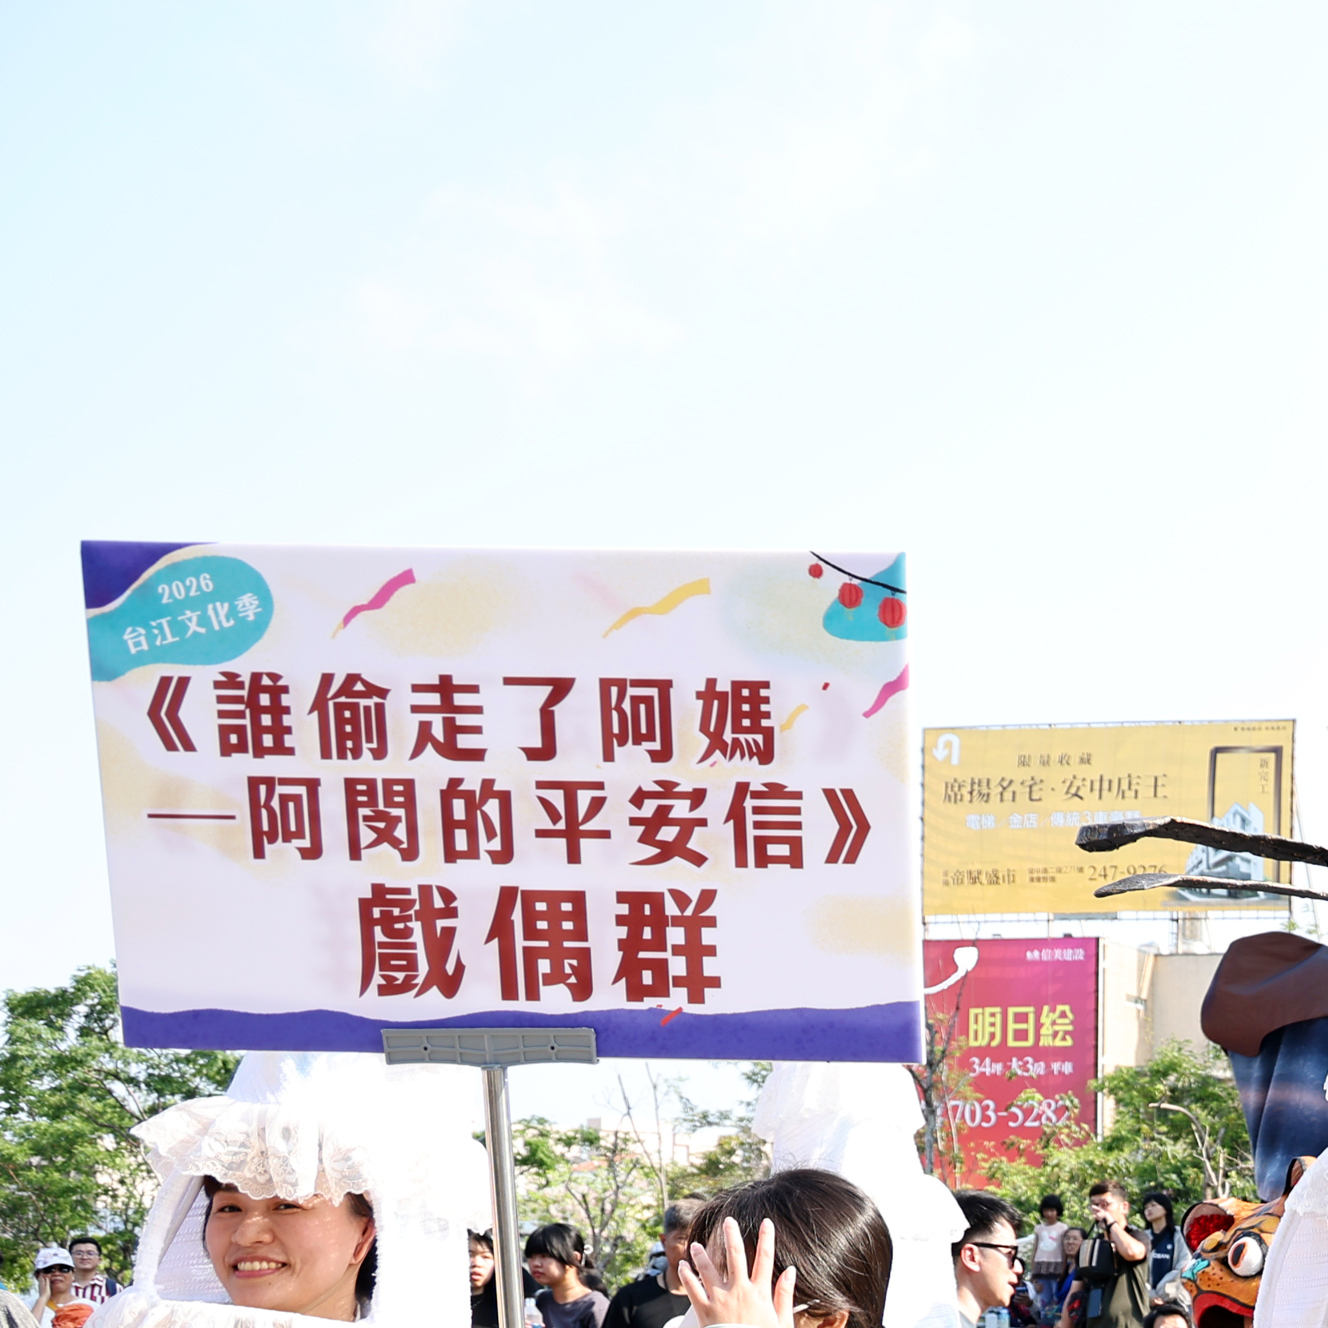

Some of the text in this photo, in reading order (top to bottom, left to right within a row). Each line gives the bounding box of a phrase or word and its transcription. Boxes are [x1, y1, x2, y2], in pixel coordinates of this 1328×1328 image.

[158, 573, 214, 604] 2026
[123, 592, 262, 654] 台江文化季
[146, 671, 776, 765] 《誰偷走了阿媽
[1017, 752, 1093, 767] 限量收藏
[359, 883, 722, 1004] 戲偶群
[968, 1004, 1075, 1048] 明日絵
